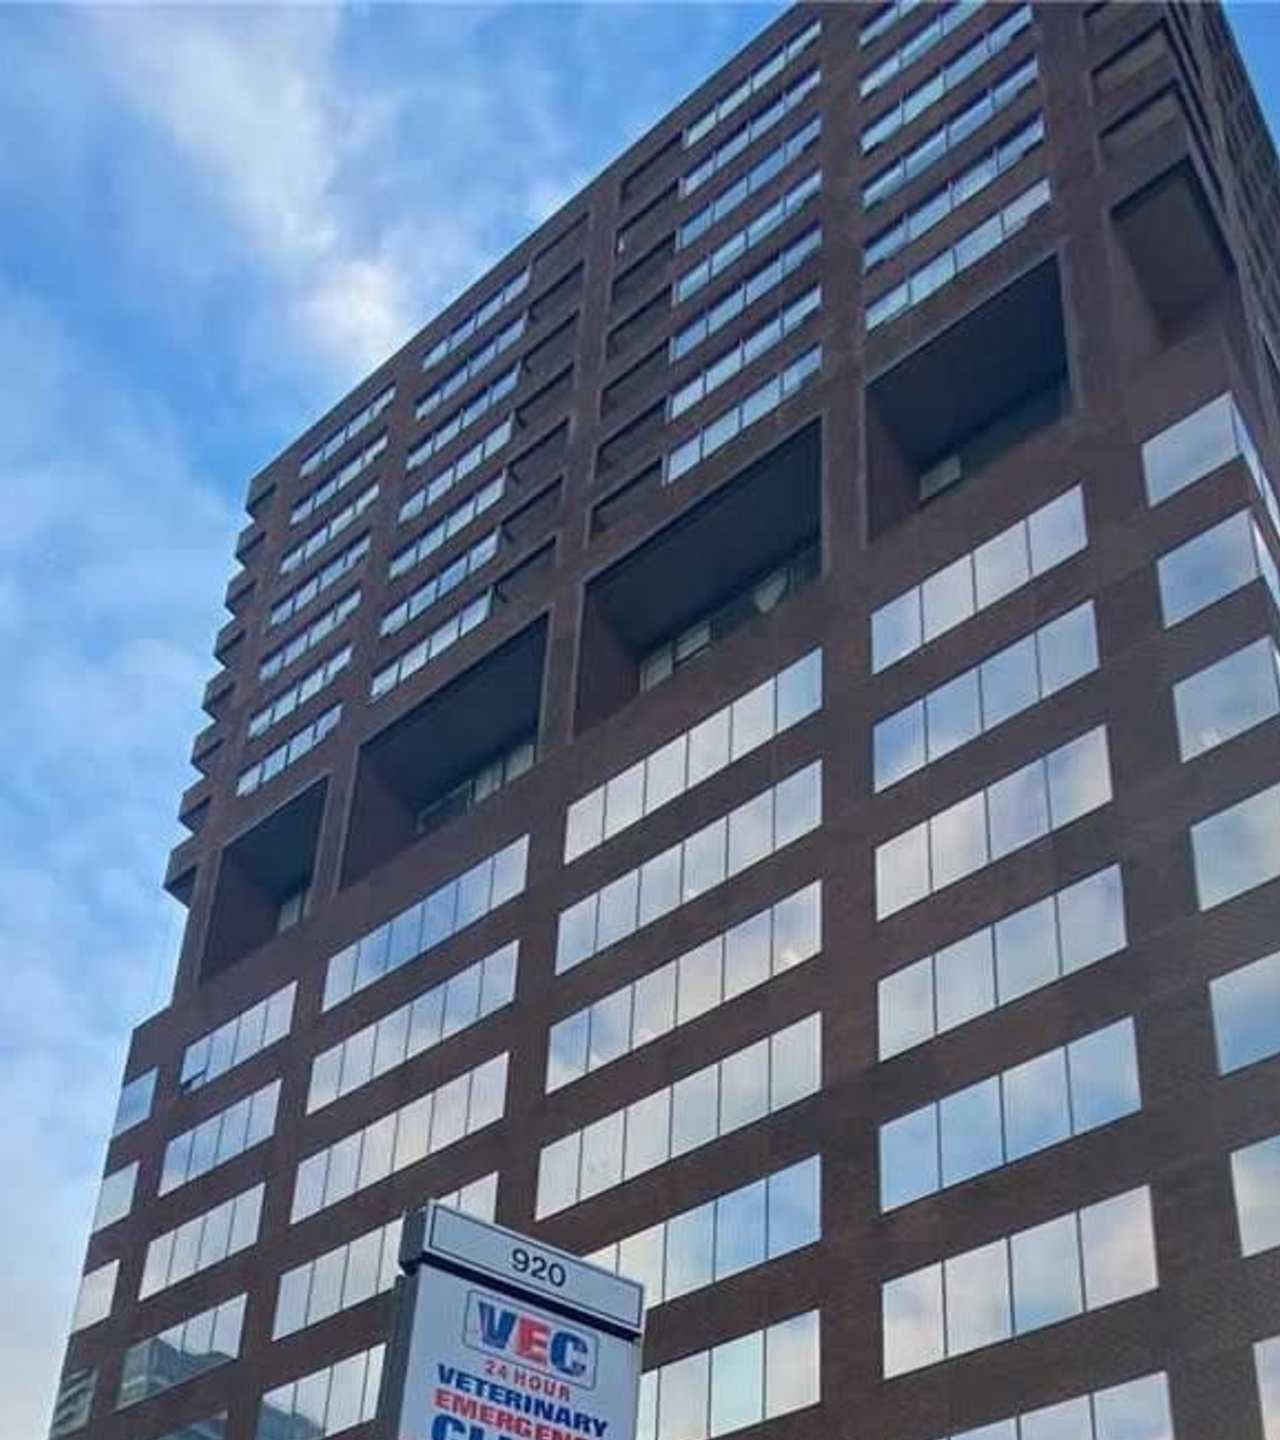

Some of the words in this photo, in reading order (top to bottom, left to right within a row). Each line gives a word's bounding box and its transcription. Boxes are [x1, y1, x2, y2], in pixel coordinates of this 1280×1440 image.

[511, 1248, 566, 1288] 920
[478, 1301, 589, 1377] VEC
[436, 1364, 608, 1438] VETERINARY
[515, 1371, 572, 1402] HOUR
